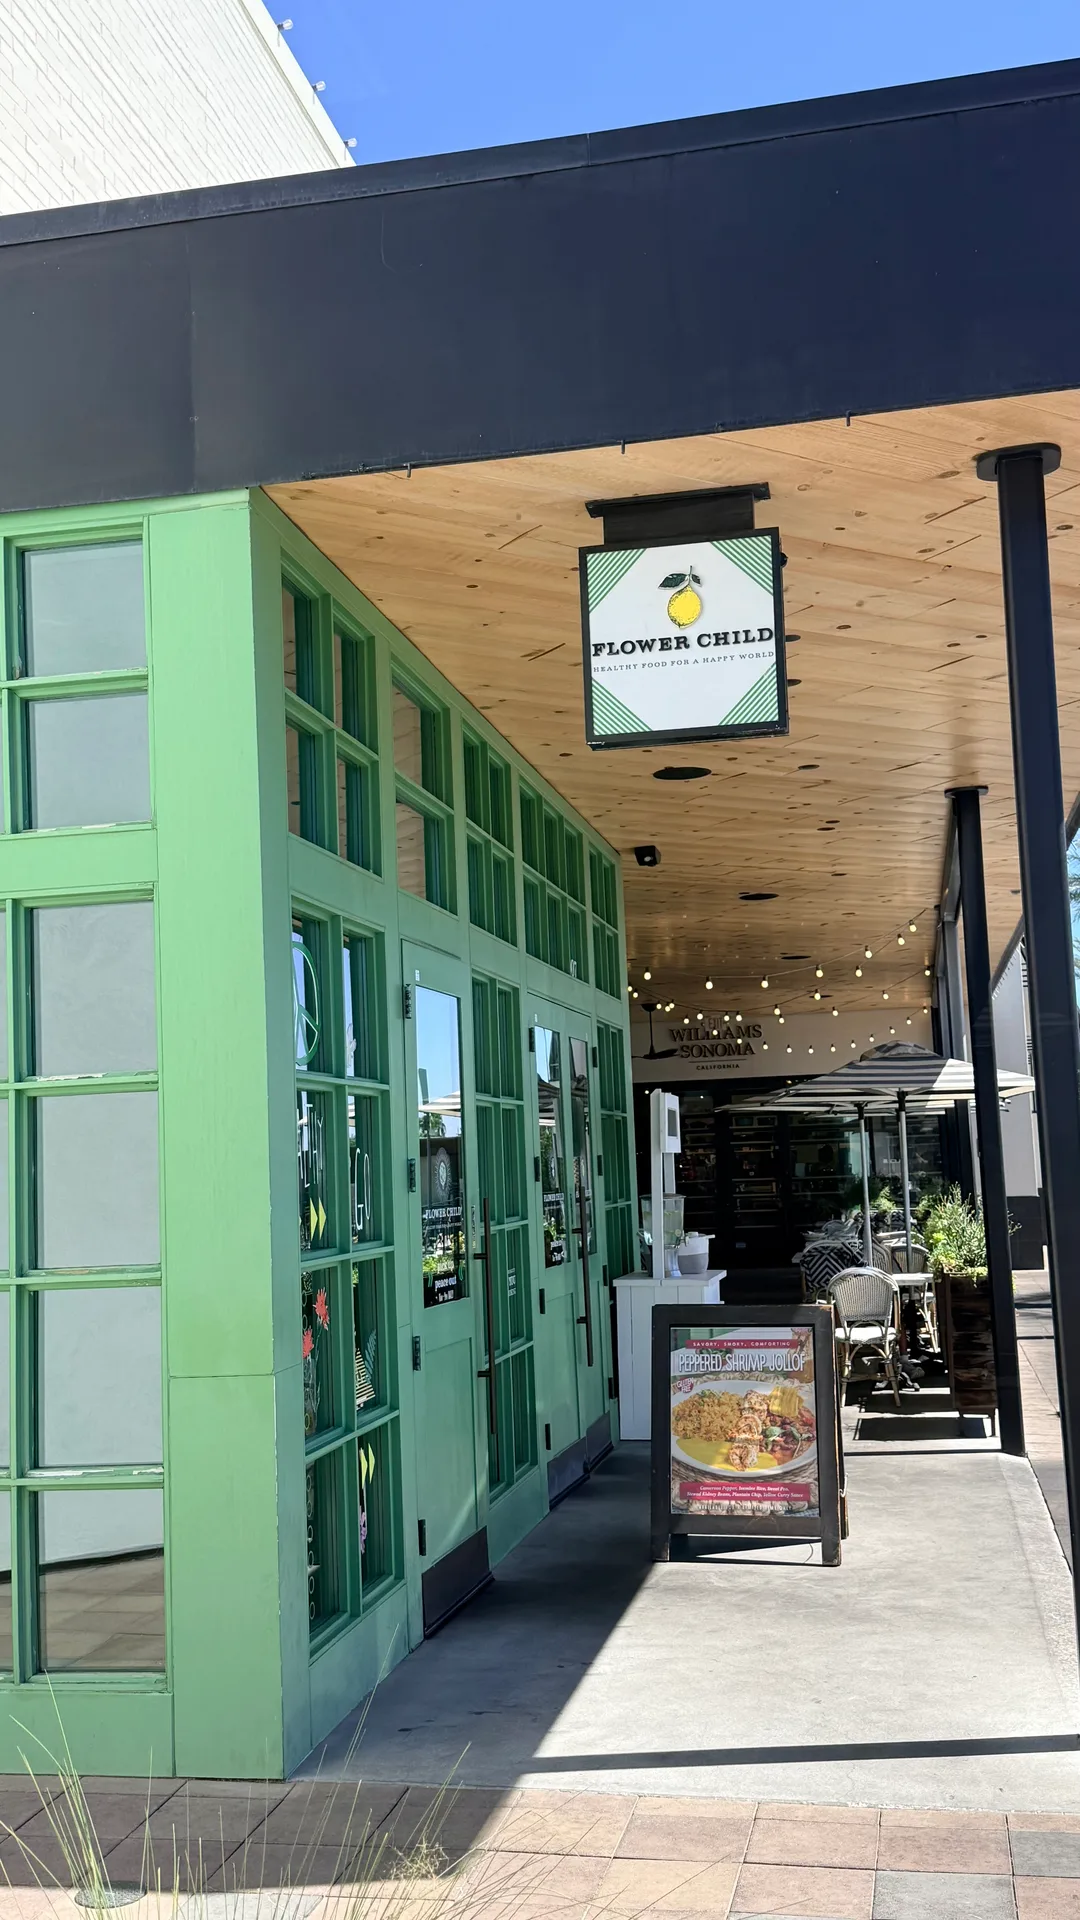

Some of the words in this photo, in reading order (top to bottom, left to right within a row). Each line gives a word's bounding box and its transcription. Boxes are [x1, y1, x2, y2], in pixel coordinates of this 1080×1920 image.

[592, 635, 690, 656] FLOWER
[697, 627, 774, 648] CHILD
[593, 663, 638, 672] HEALTHY
[641, 661, 667, 669] FOOD
[703, 655, 735, 663] HAPPY
[739, 651, 774, 660] WORLD
[680, 1042, 756, 1058] SONOMA
[679, 1353, 722, 1372] PEPPERED
[725, 1353, 766, 1371] SHRIMP
[769, 1353, 805, 1371] JOLLOF
